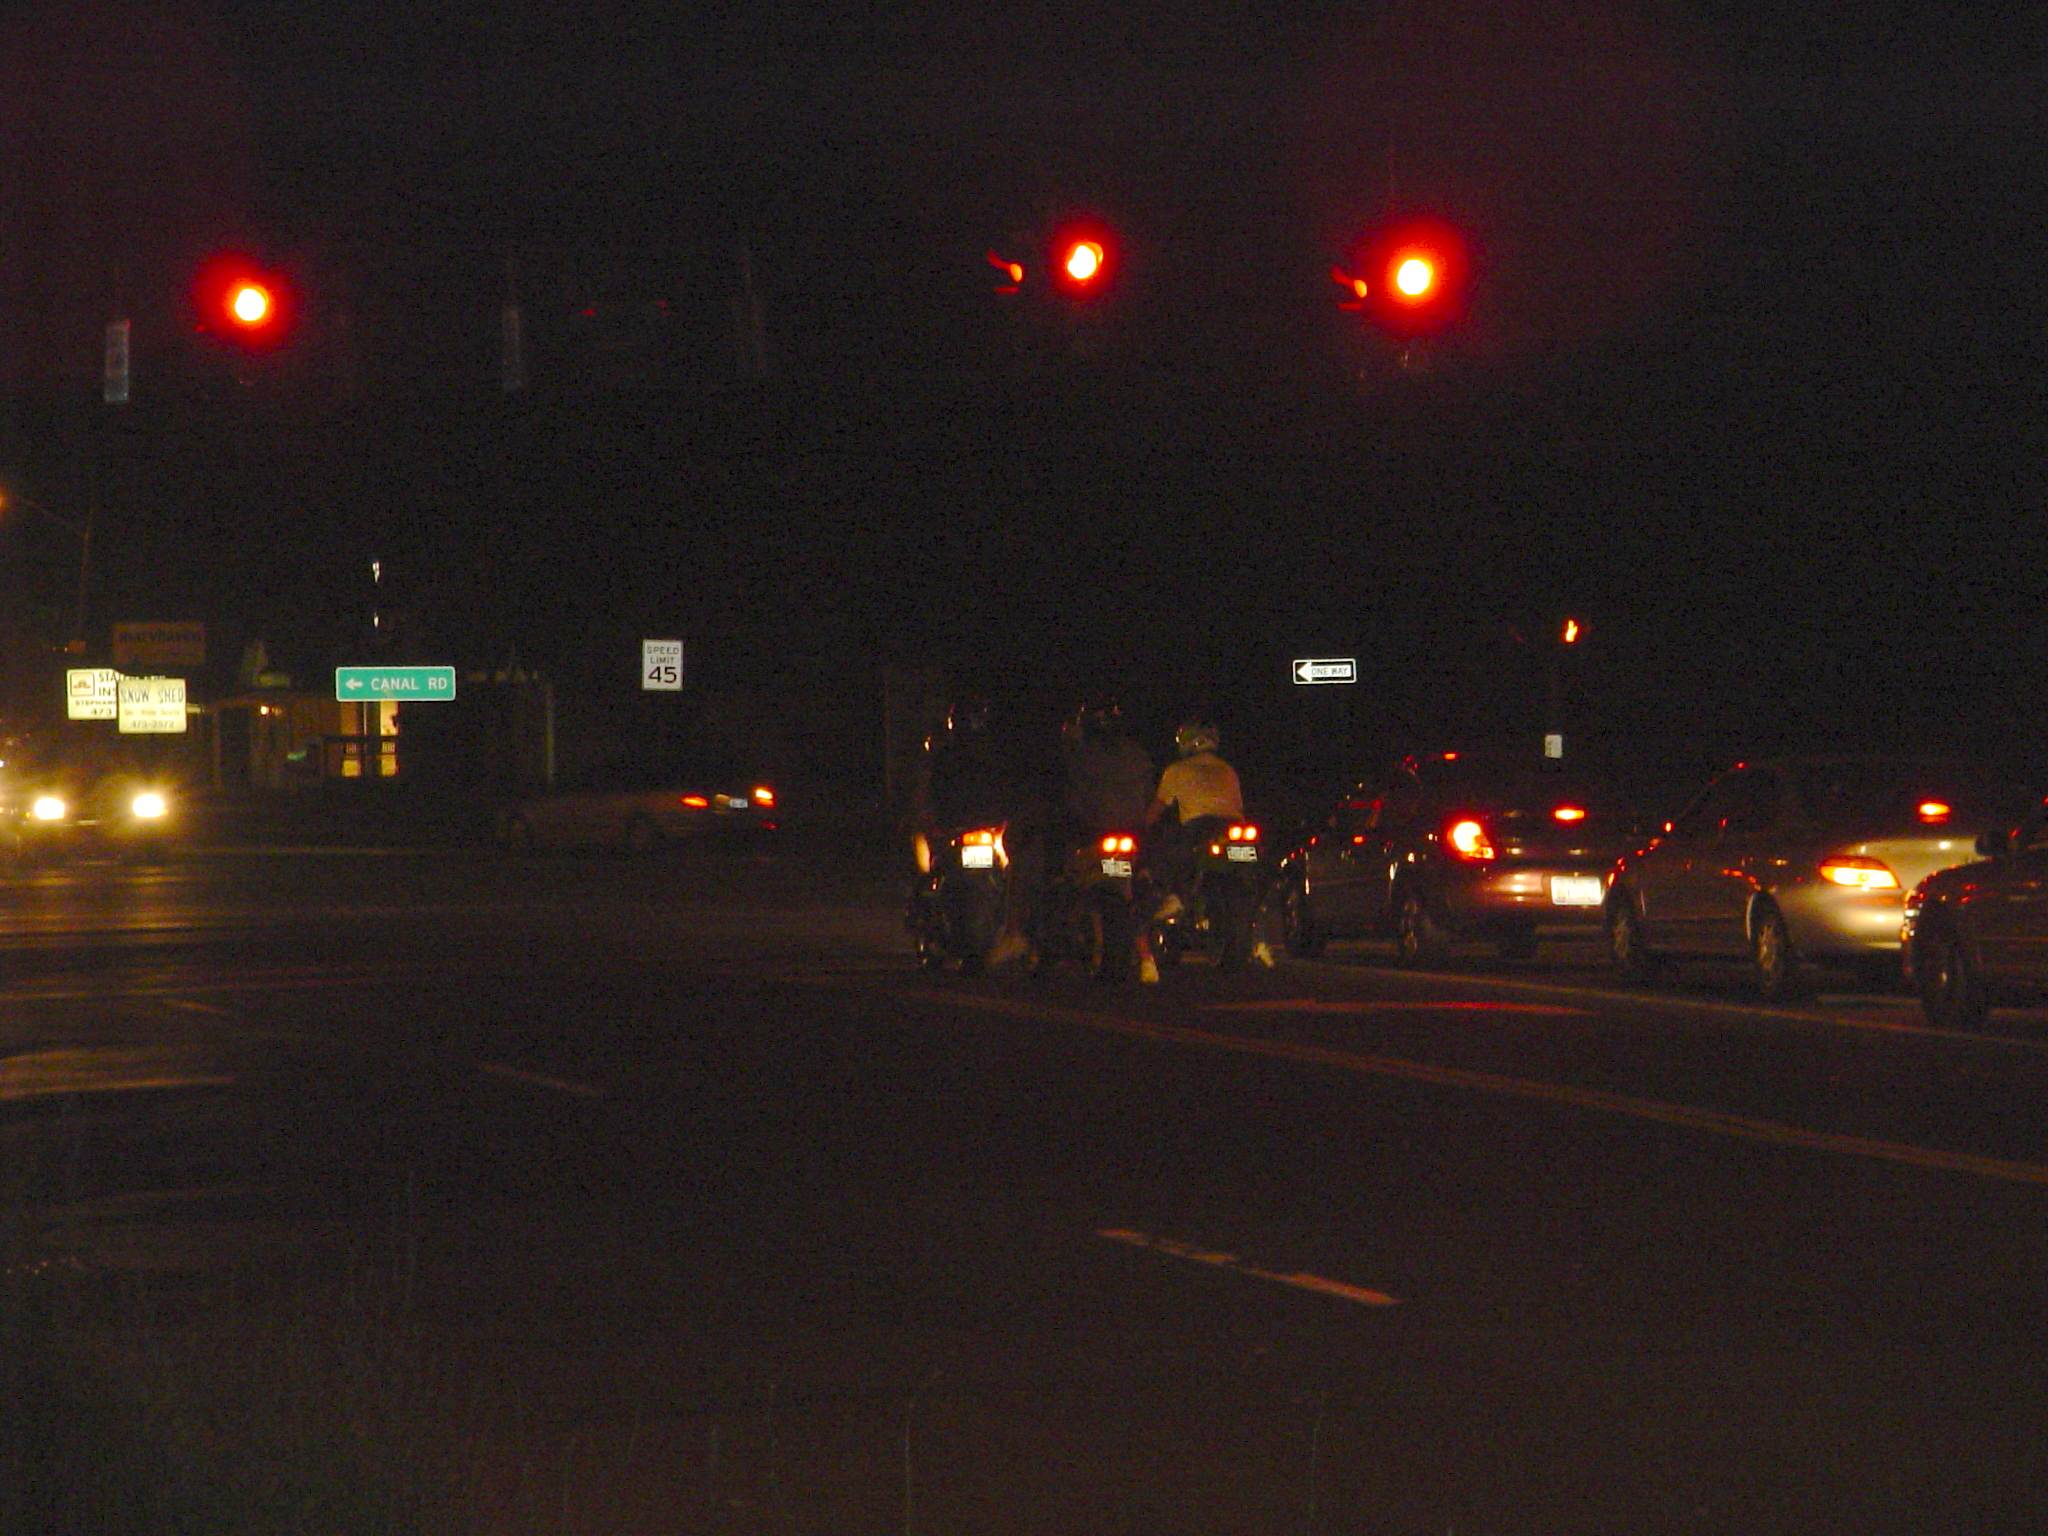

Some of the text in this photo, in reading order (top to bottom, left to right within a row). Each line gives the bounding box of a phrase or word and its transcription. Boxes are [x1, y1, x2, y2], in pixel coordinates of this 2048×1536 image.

[647, 646, 679, 654] SPEED
[650, 656, 675, 664] LIMIT
[648, 666, 677, 684] 45
[1311, 667, 1348, 675] ONE WAY
[371, 677, 447, 690] CANAL RD
[120, 687, 184, 704] SNOW SHED
